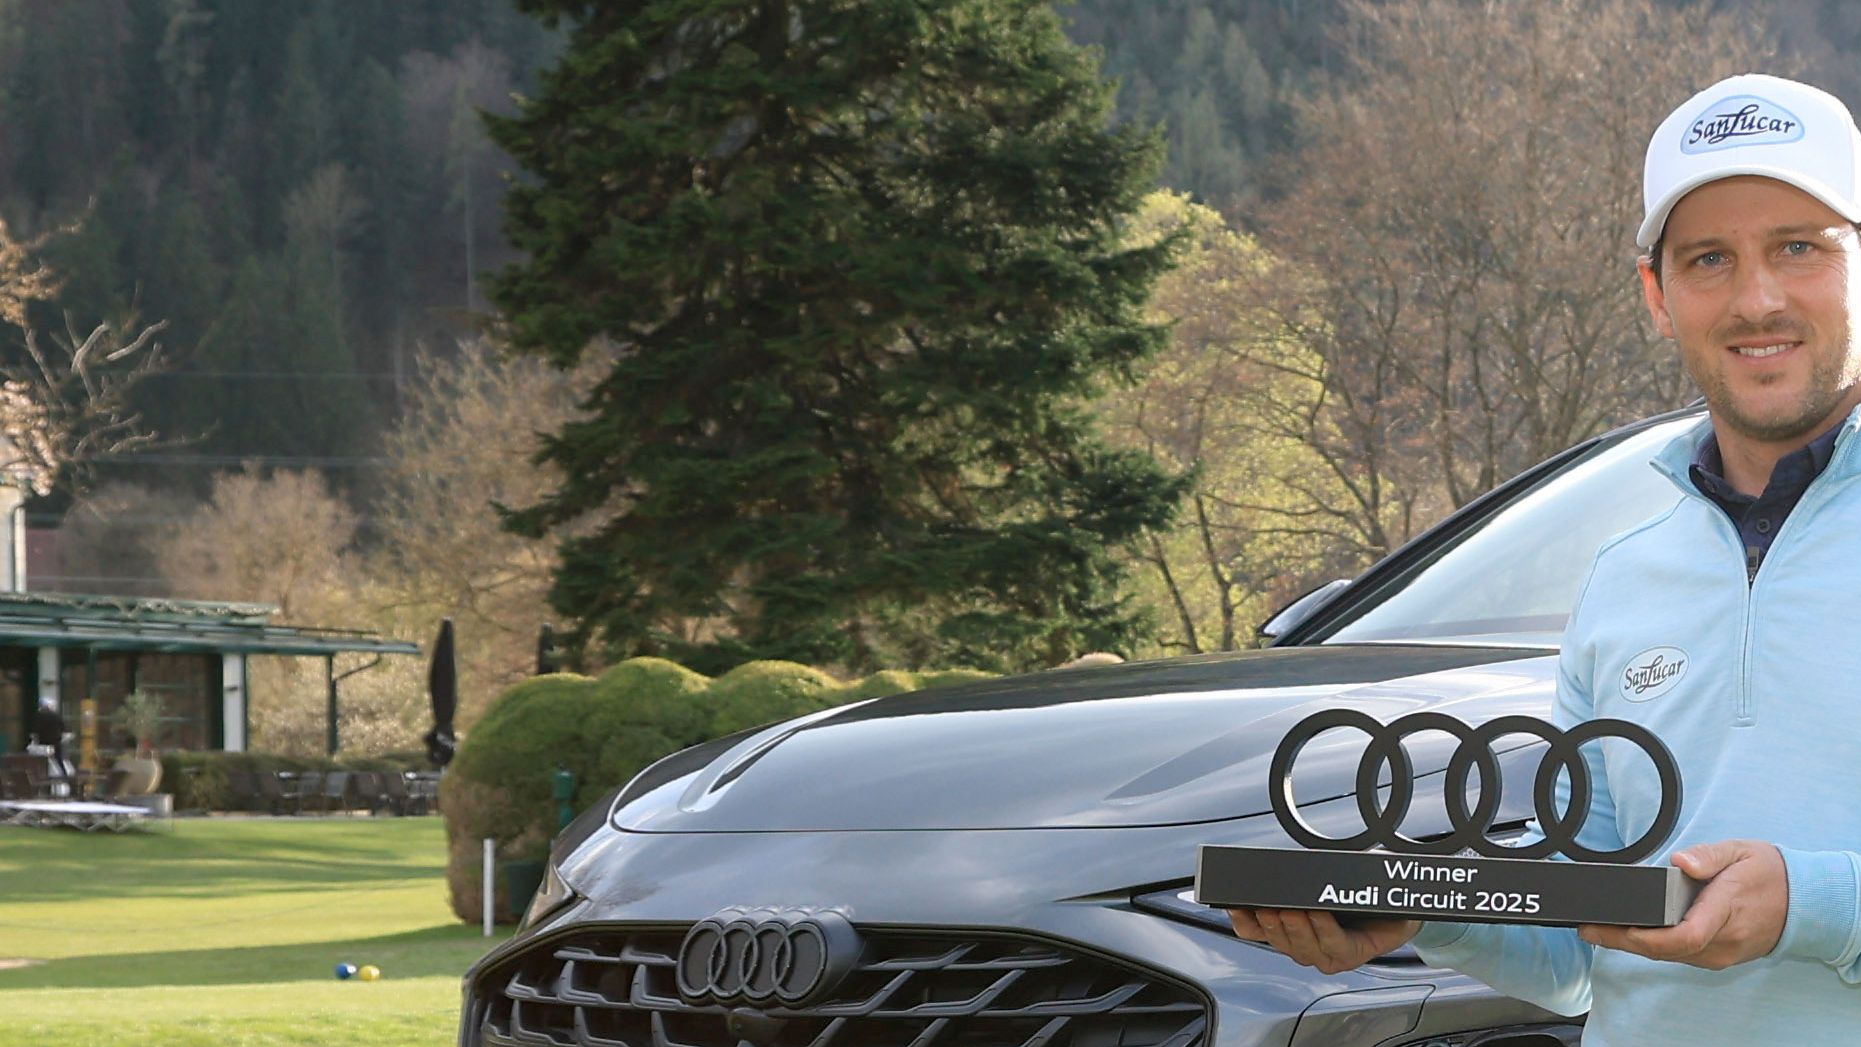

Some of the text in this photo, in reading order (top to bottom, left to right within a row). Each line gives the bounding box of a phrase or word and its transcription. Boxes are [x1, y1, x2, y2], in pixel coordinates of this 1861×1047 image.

[1689, 104, 1796, 144] SanLucar
[1624, 655, 1685, 694] SanLucar
[1384, 860, 1478, 883] Winner
[1318, 884, 1540, 913] Audi Circuit 2025
